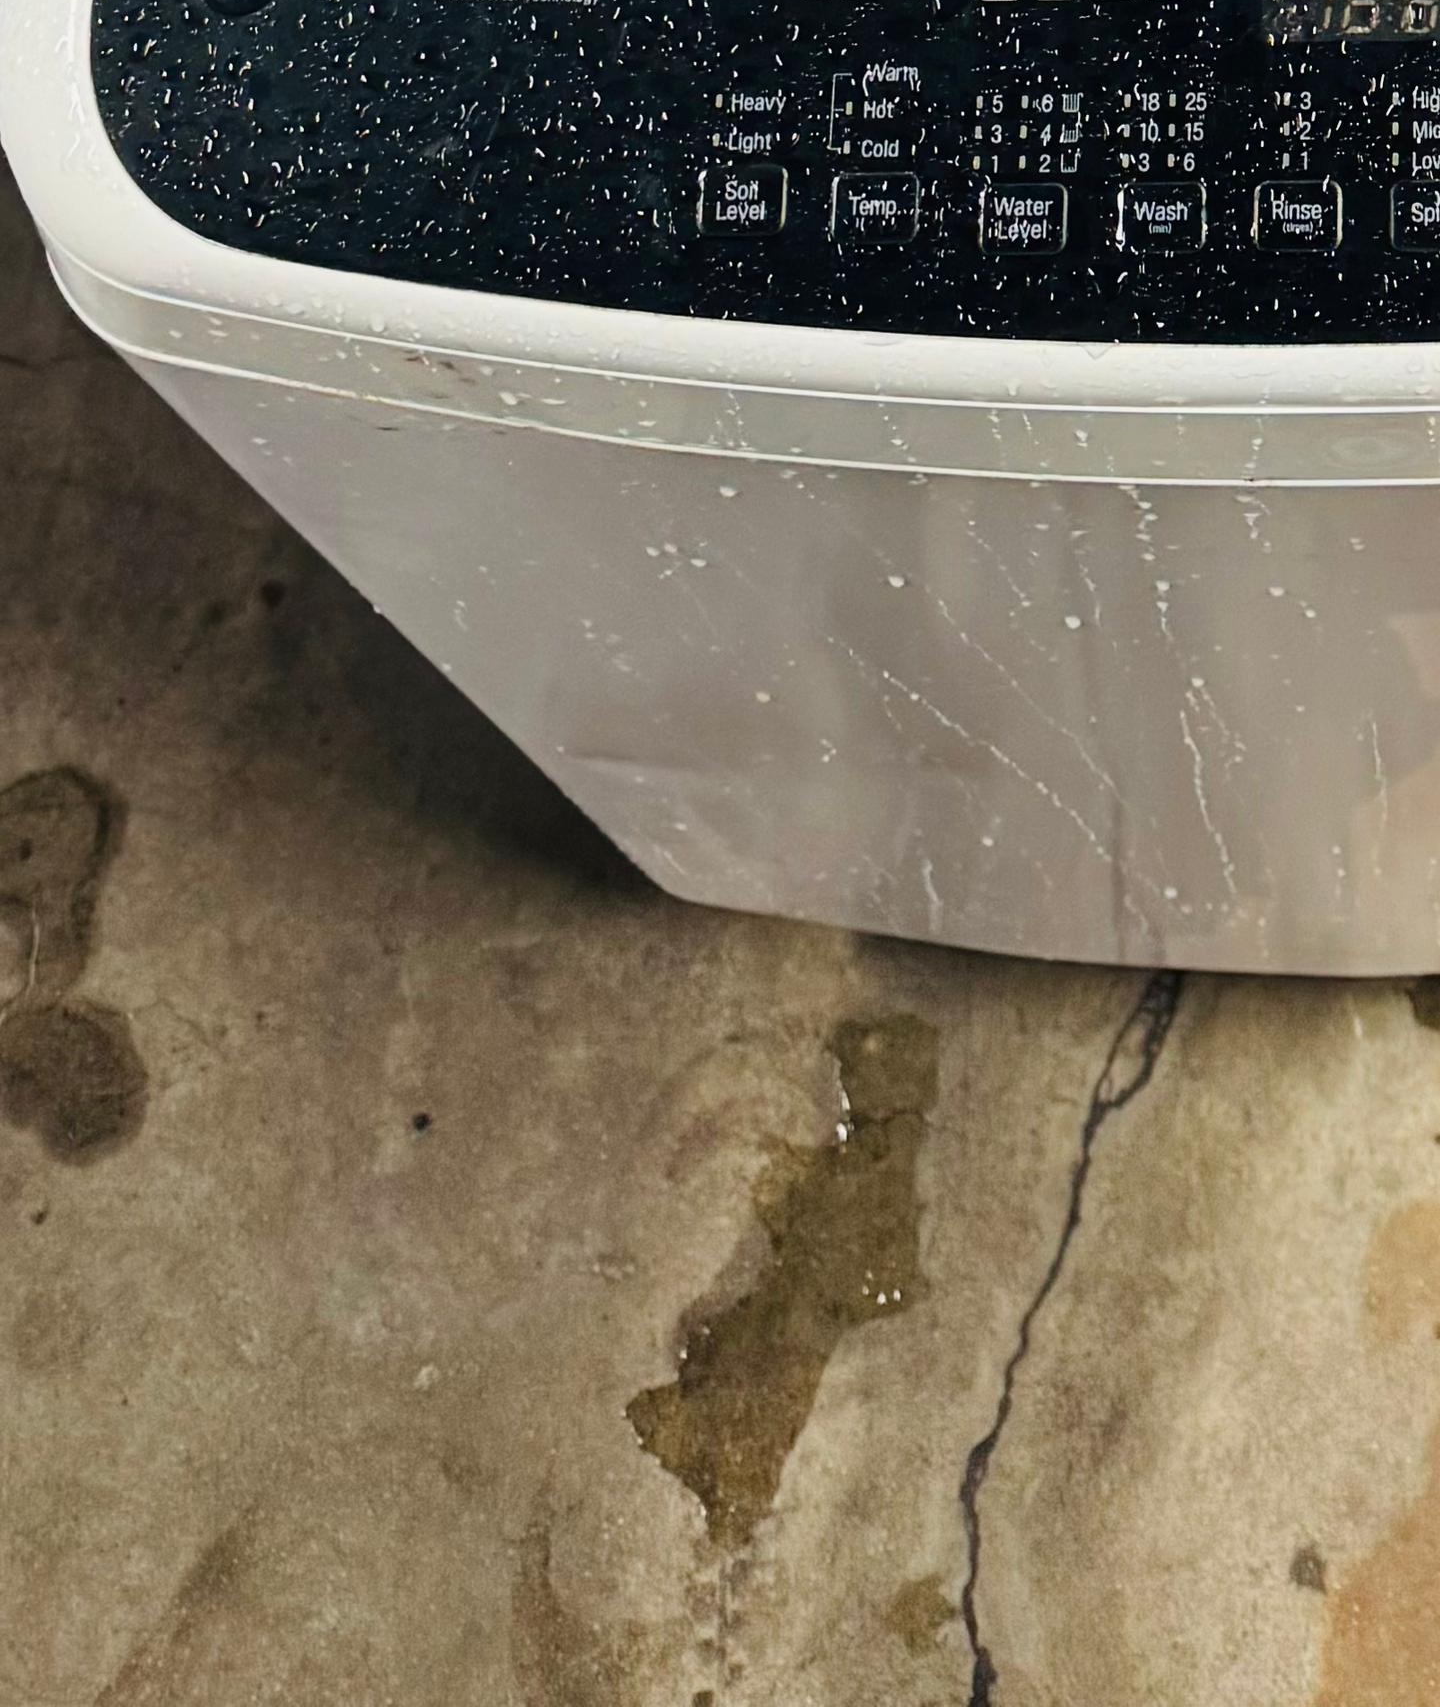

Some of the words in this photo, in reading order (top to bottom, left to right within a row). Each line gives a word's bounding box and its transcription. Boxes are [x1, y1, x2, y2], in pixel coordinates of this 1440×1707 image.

[867, 63, 918, 83] Warm
[732, 93, 786, 114] Heavy
[863, 100, 895, 119] Hot
[992, 94, 1003, 114] 5
[1041, 94, 1053, 113] 6
[1141, 92, 1160, 112] 18
[1185, 92, 1207, 112] 25
[1300, 91, 1311, 110] 3
[991, 124, 1002, 144] 3
[1040, 124, 1051, 143] 4
[1140, 123, 1159, 143] 10
[1185, 122, 1204, 141] 15
[1300, 121, 1311, 141] 2
[728, 133, 771, 153] Light
[861, 139, 899, 158] Cold
[991, 155, 998, 174] 1
[1039, 155, 1050, 173] 2
[1138, 153, 1150, 172] 3
[1183, 153, 1195, 172] 6
[1301, 152, 1308, 171] 1
[725, 179, 759, 200] Soil
[716, 200, 766, 221] Level
[993, 196, 1053, 217] Water
[1134, 200, 1189, 221] Wash
[1272, 200, 1322, 221] Rinse
[998, 219, 1048, 240] Level
[1149, 222, 1172, 234] (min)
